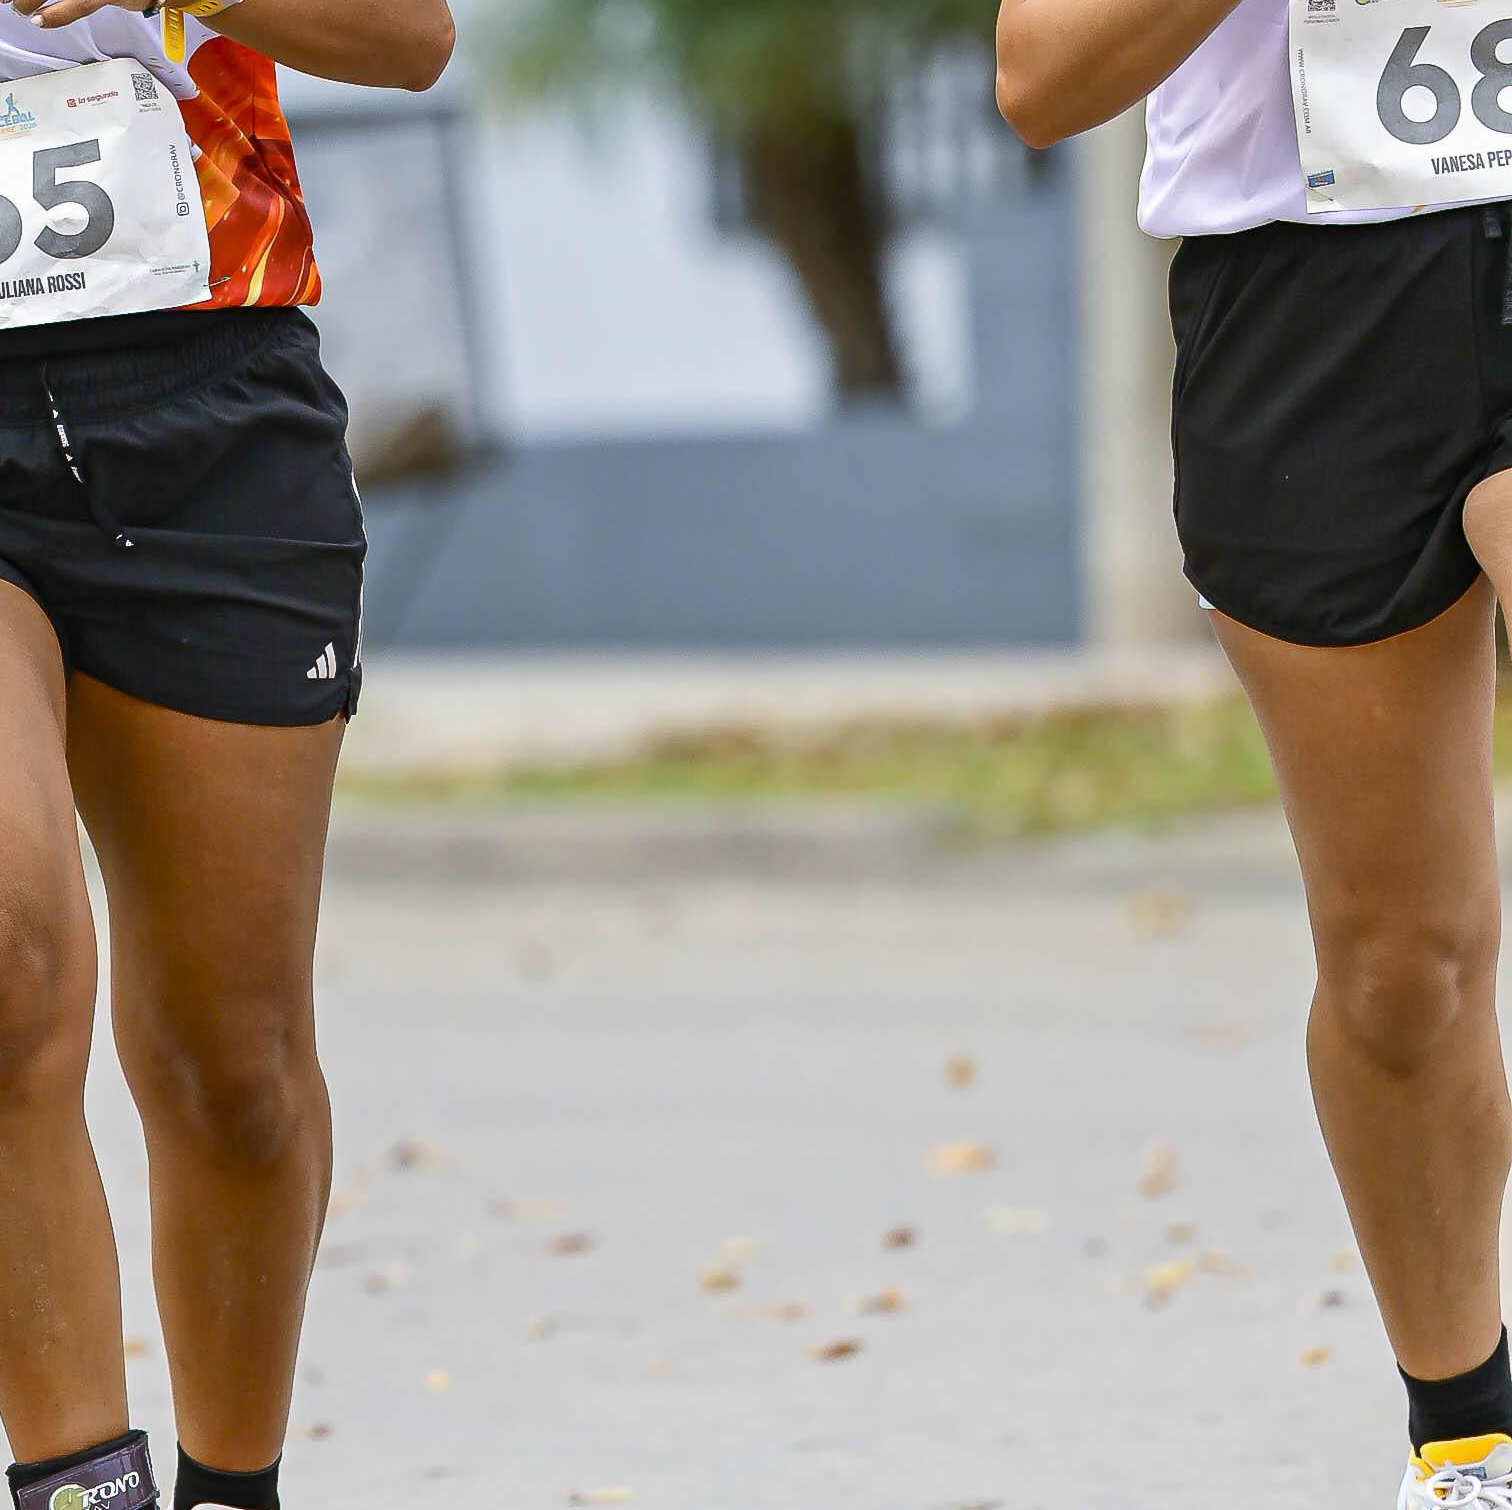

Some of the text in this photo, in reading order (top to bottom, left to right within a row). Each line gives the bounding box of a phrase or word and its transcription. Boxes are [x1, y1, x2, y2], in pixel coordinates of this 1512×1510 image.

[1376, 18, 1512, 145] 68
[1430, 149, 1512, 175] VANESA PEP
[46, 271, 86, 294] ROSSI
